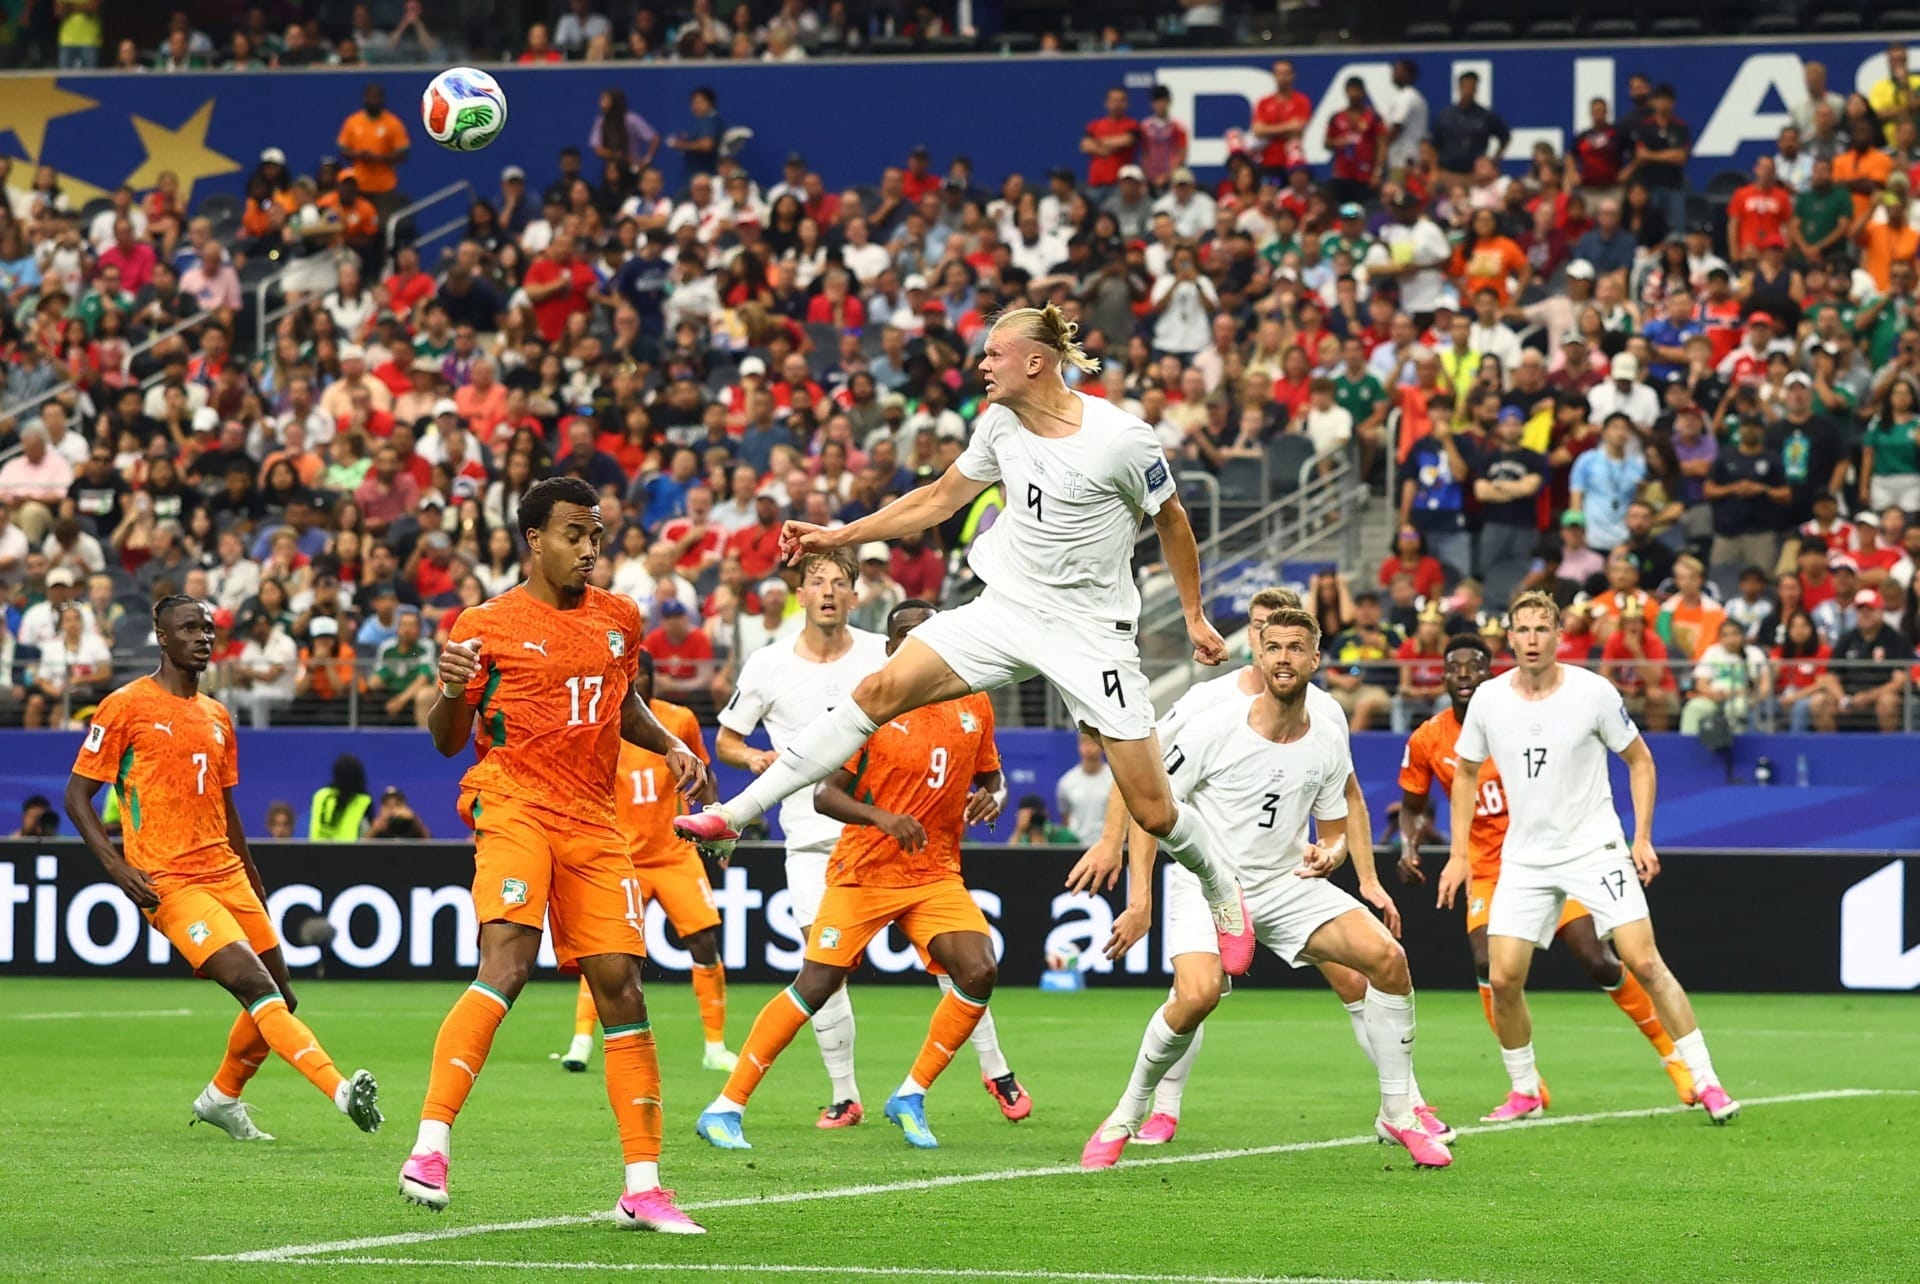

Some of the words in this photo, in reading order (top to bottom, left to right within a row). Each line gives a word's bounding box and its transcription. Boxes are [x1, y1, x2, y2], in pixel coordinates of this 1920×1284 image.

[1156, 47, 1920, 167] DALA
[1027, 483, 1043, 522] 9
[565, 675, 604, 726] 17
[1102, 669, 1126, 708] 9
[192, 753, 208, 795] 7
[927, 747, 949, 789] 9
[1523, 748, 1547, 778] 17
[630, 768, 658, 804] 11
[1258, 793, 1281, 828] 3
[1600, 869, 1627, 901] 17
[265, 866, 808, 972] concts
